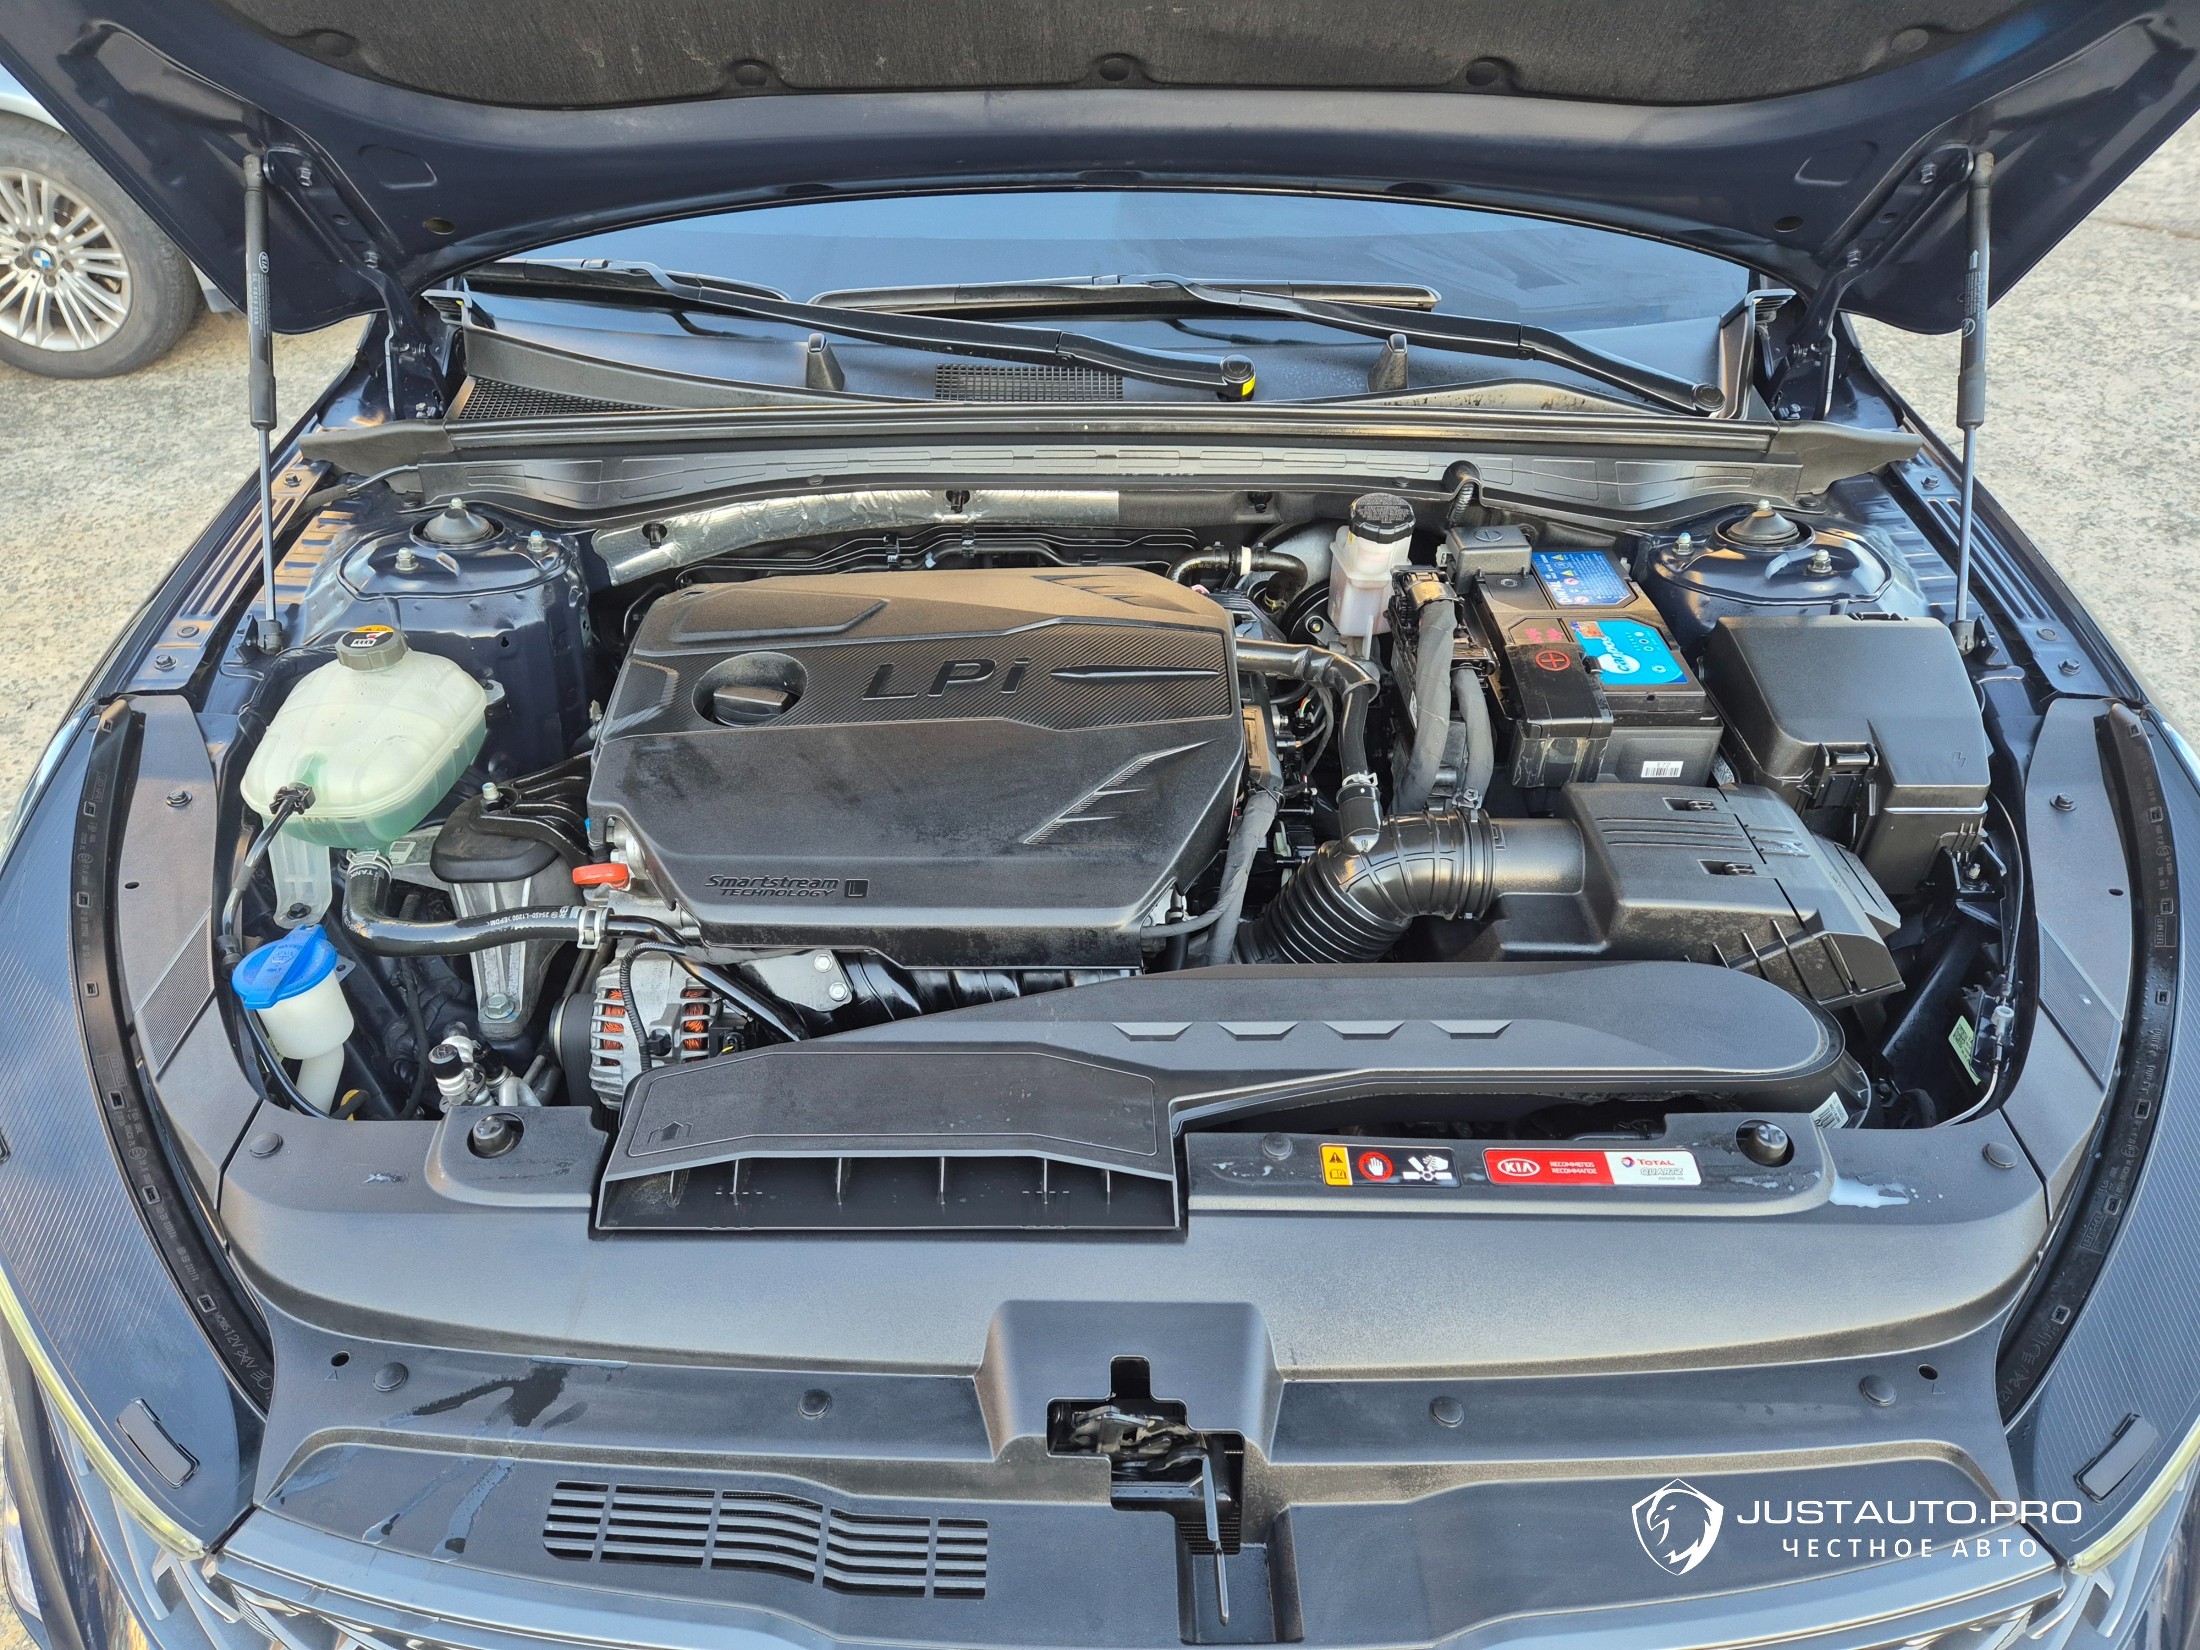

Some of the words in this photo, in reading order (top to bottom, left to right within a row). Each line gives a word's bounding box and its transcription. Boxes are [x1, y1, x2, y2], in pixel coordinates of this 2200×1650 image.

[260, 252, 269, 273] KIA
[862, 657, 1030, 700] LPi
[302, 816, 329, 824] MAX
[349, 868, 374, 879] TANK
[705, 874, 840, 889] Smartstream
[720, 887, 836, 897] TECHNOLOGY
[1502, 1160, 1536, 1174] KIA
[1637, 1158, 1675, 1166] TOTAL
[1640, 1167, 1684, 1176] QUARTZ
[225, 1329, 244, 1348] 12V
